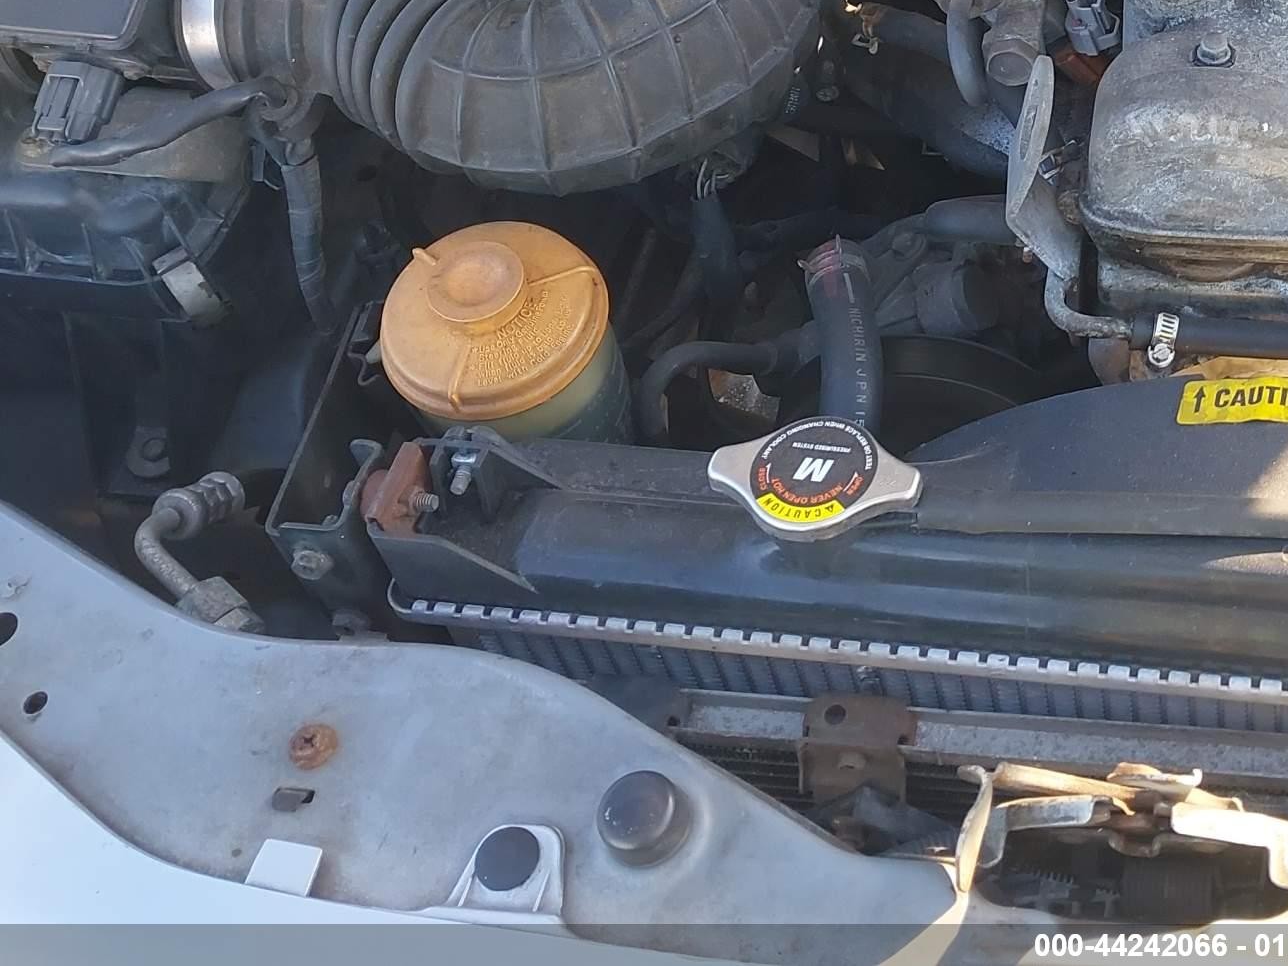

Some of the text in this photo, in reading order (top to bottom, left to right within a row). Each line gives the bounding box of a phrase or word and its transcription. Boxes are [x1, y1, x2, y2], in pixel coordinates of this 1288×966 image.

[496, 336, 514, 348] Only
[849, 307, 867, 362] NICHIRIN
[824, 421, 846, 431] WHEN
[844, 425, 868, 447] REPLACE
[761, 433, 787, 460] COOLANT
[792, 442, 814, 450] SYSTEM
[864, 444, 872, 455] OR
[792, 457, 835, 482] M
[771, 478, 843, 504] NEVER OPEN HOT
[845, 476, 864, 495] OPEN
[764, 497, 821, 518] CAUTION
